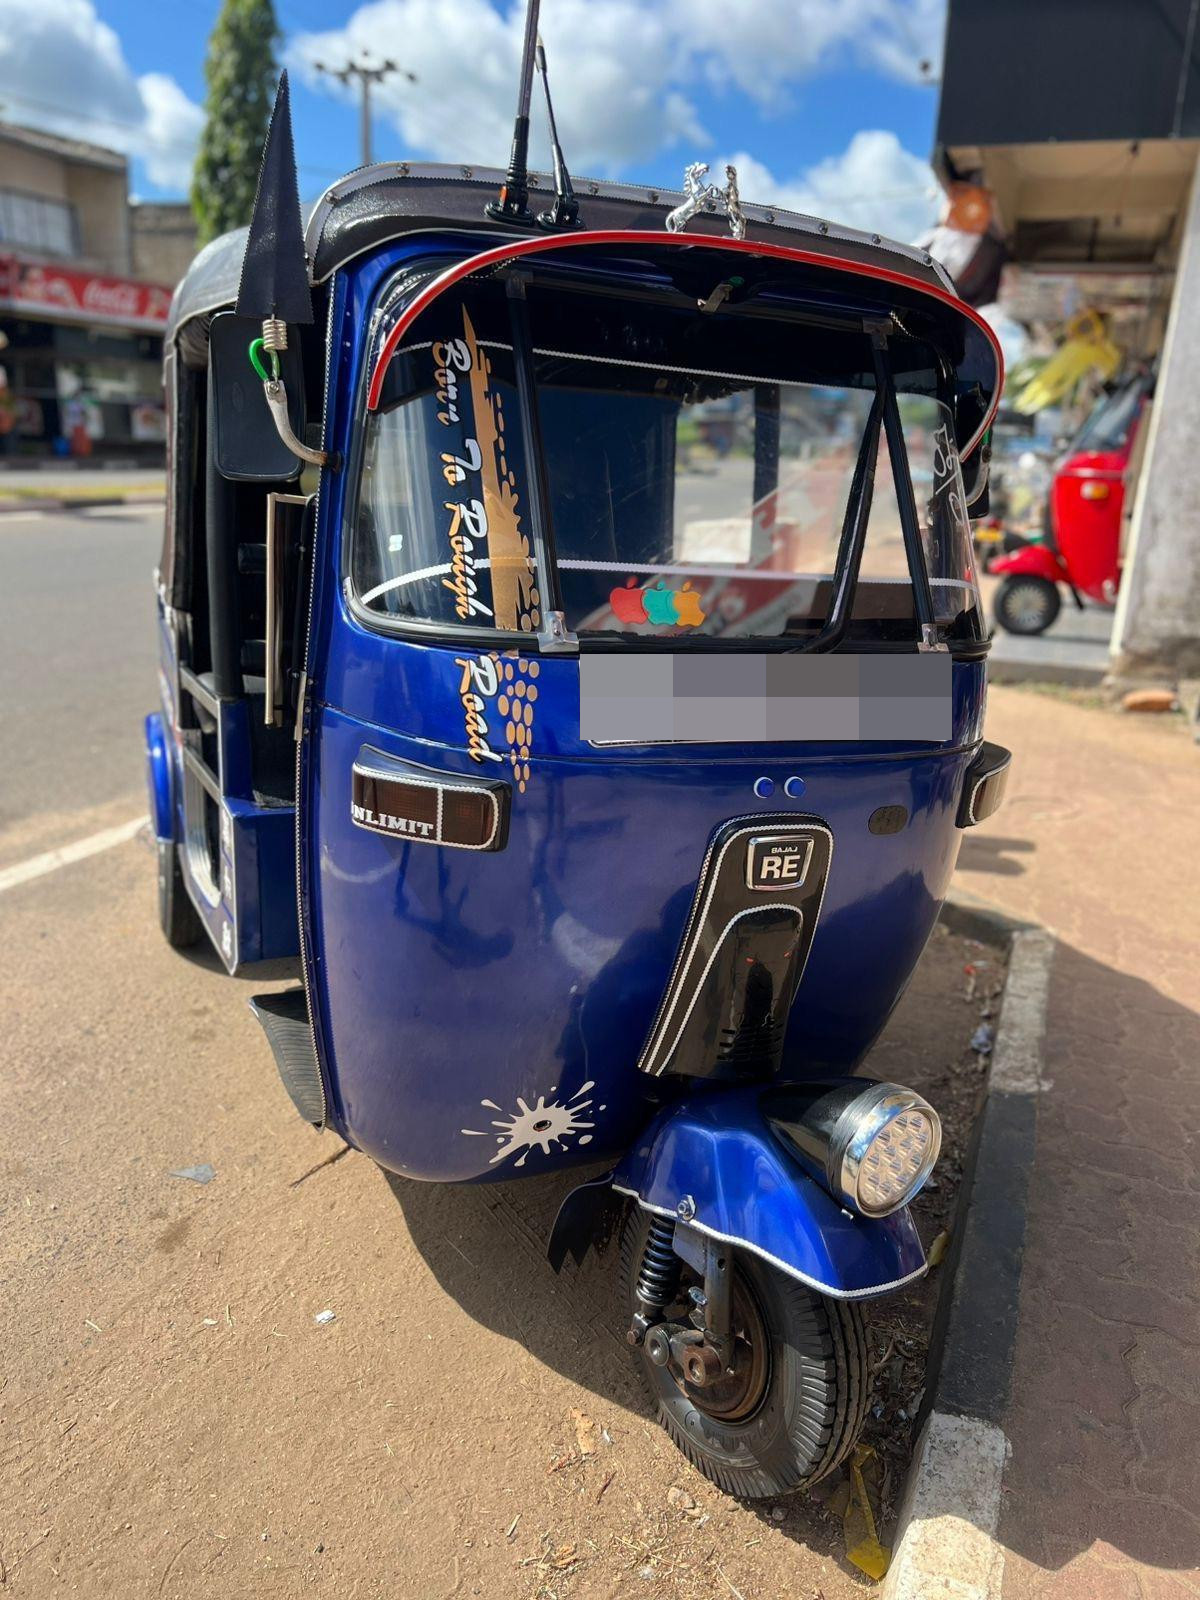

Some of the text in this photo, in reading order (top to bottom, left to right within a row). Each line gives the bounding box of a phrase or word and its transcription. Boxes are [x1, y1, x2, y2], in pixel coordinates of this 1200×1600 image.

[432, 339, 503, 762] Born To Rough Road
[352, 801, 433, 836] NLIMIT
[771, 846, 798, 854] BAJAJ
[760, 855, 801, 879] RE
